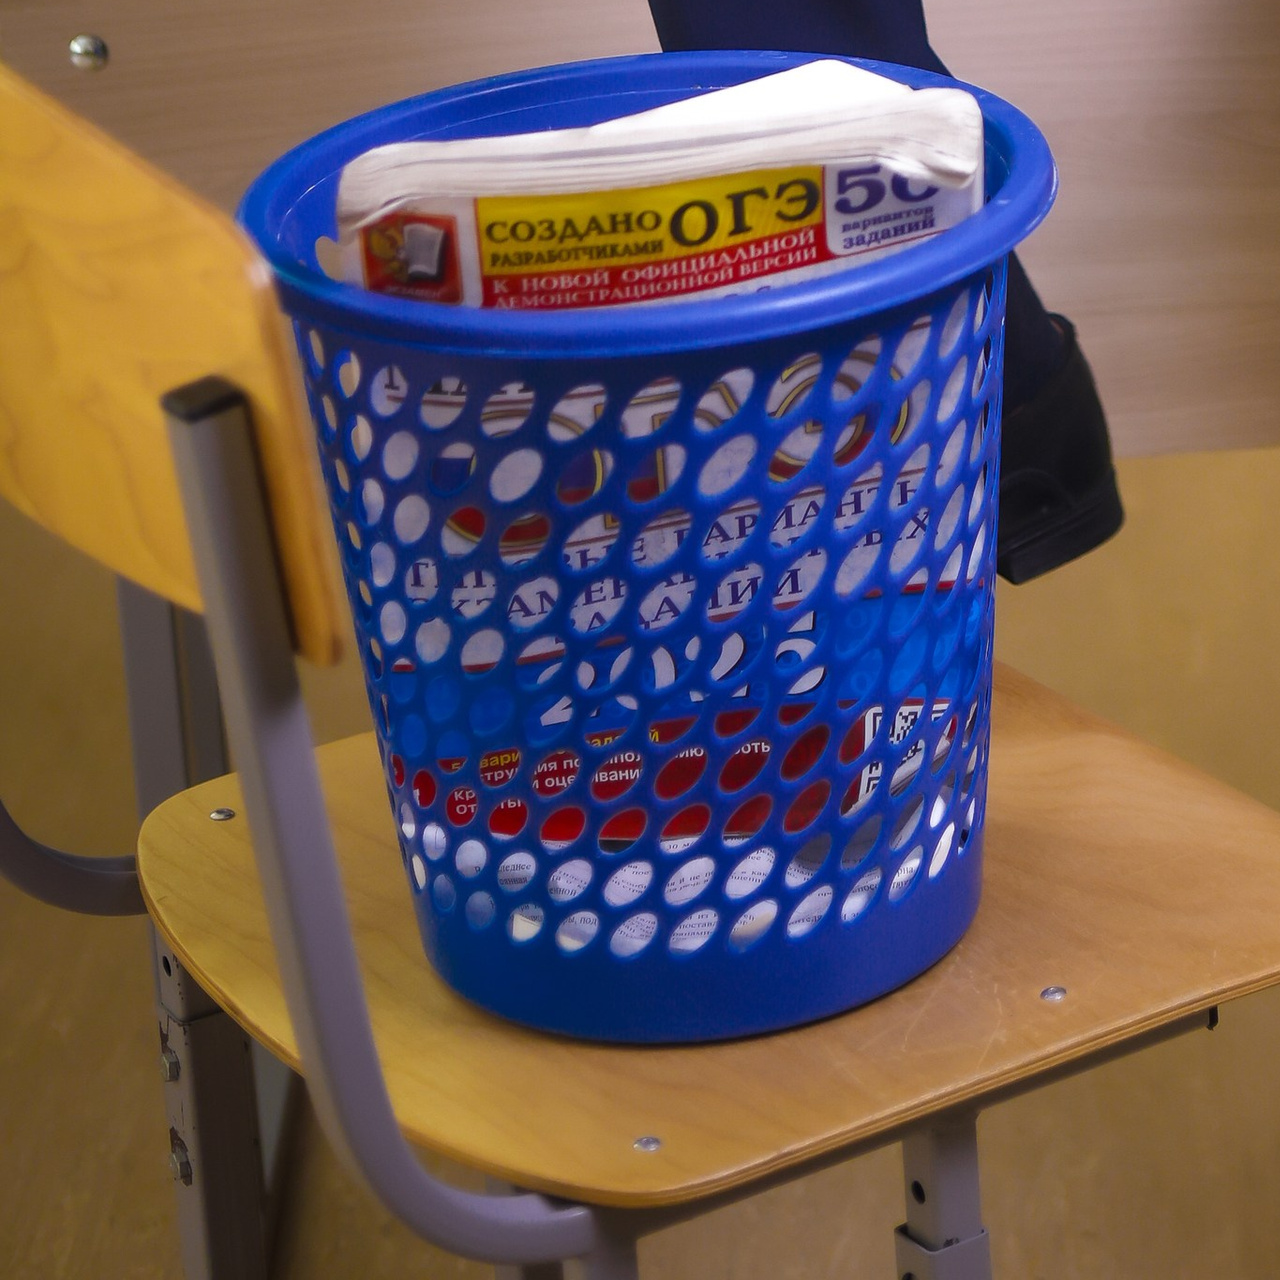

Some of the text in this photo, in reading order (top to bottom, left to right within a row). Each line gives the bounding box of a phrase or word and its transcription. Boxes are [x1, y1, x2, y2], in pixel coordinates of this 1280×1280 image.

[485, 177, 821, 248] СОЗДАНО ОГЭ
[842, 205, 934, 234] вариантов
[843, 216, 936, 250] заданий
[490, 239, 665, 268] РАЗРАБОТЧИКАМИ
[493, 228, 816, 294] К НОВОЙ ОФИЦИАЛЬНОЙ
[740, 247, 818, 279] ВЕРСИИ
